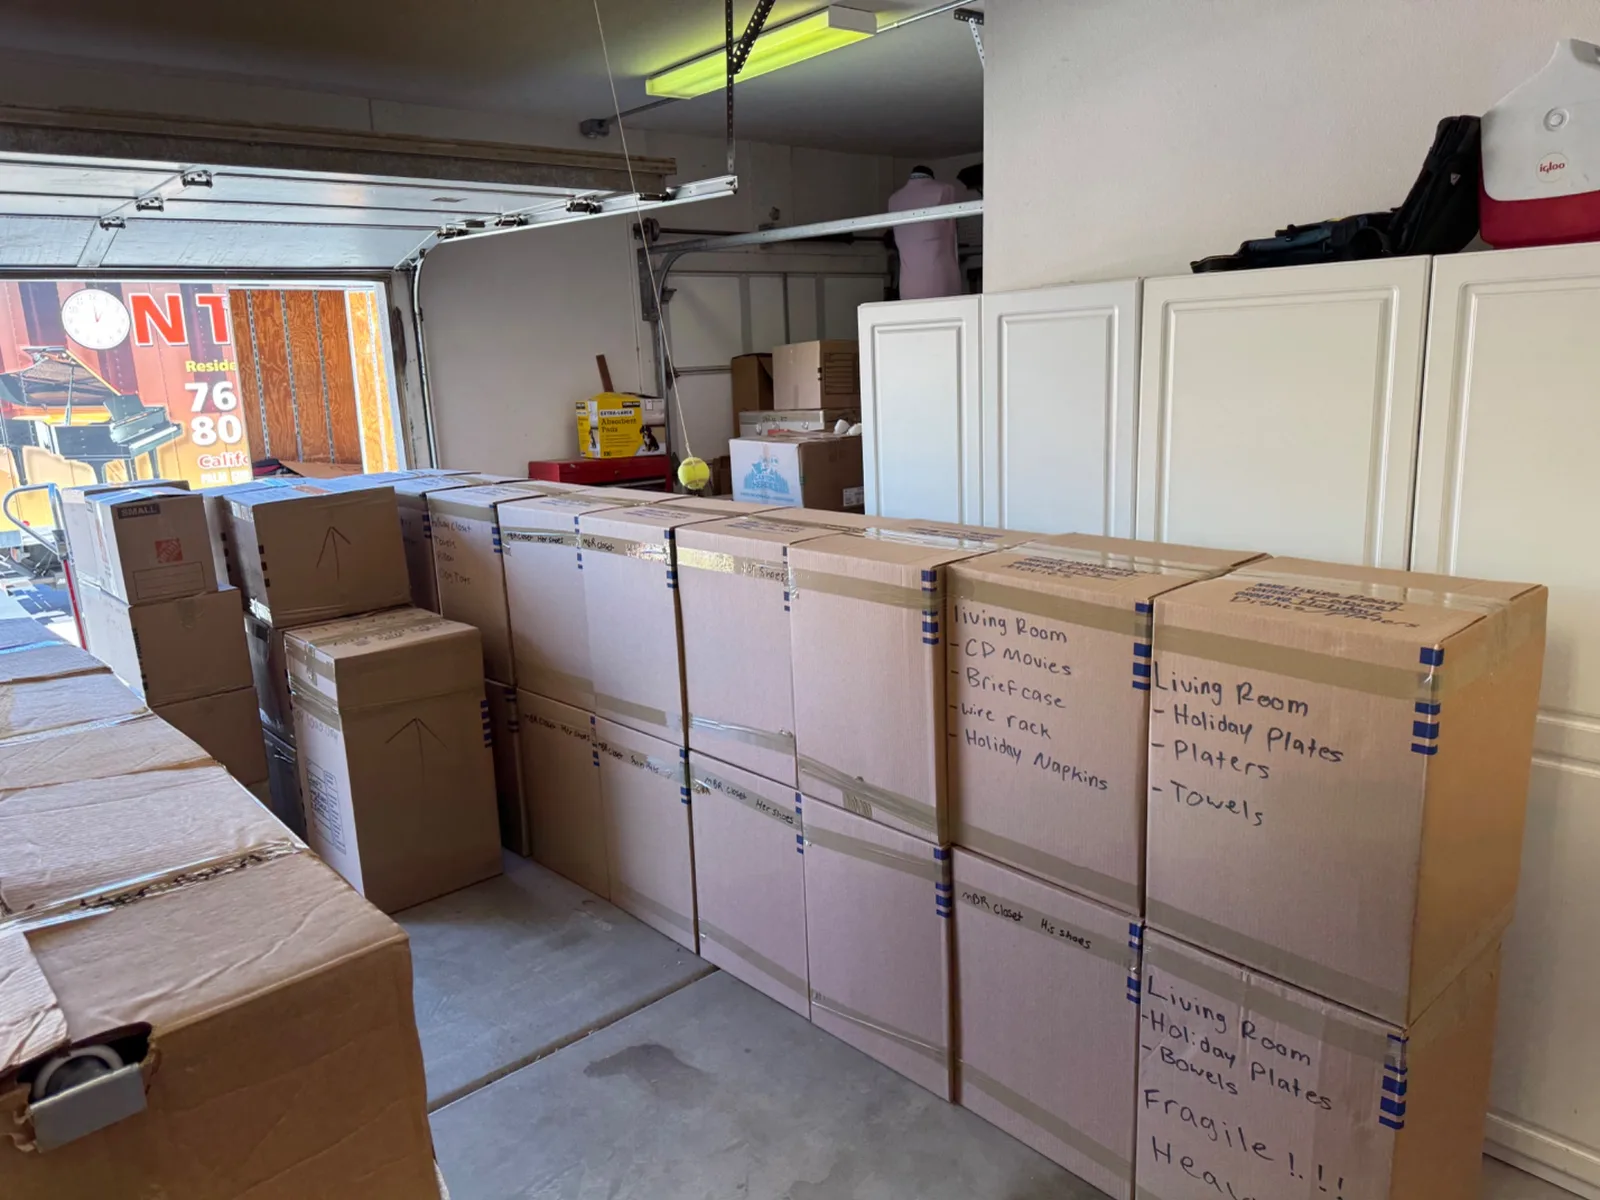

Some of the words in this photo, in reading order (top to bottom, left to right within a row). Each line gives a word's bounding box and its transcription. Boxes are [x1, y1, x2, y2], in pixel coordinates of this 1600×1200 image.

[1539, 161, 1565, 174] igloo
[184, 360, 236, 373] Reside
[184, 381, 237, 412] 76
[190, 414, 242, 446] 80
[121, 507, 157, 517] SMALL
[1015, 617, 1068, 644] Room
[965, 638, 996, 659] CD
[1154, 660, 1223, 705] Living
[1236, 681, 1309, 717] Room
[1006, 714, 1053, 740] rack
[1173, 706, 1253, 744] Holiday
[1266, 726, 1344, 764] Plates
[965, 728, 1022, 765] Holiday
[1033, 752, 1109, 791] Napkins
[1174, 739, 1270, 779] Platers
[1170, 780, 1263, 827] Towels
[1041, 918, 1055, 935] His
[1147, 975, 1227, 1034] Living
[1241, 1020, 1312, 1066] Room
[1160, 1046, 1239, 1096] Bowels
[1250, 1061, 1332, 1111] Plates
